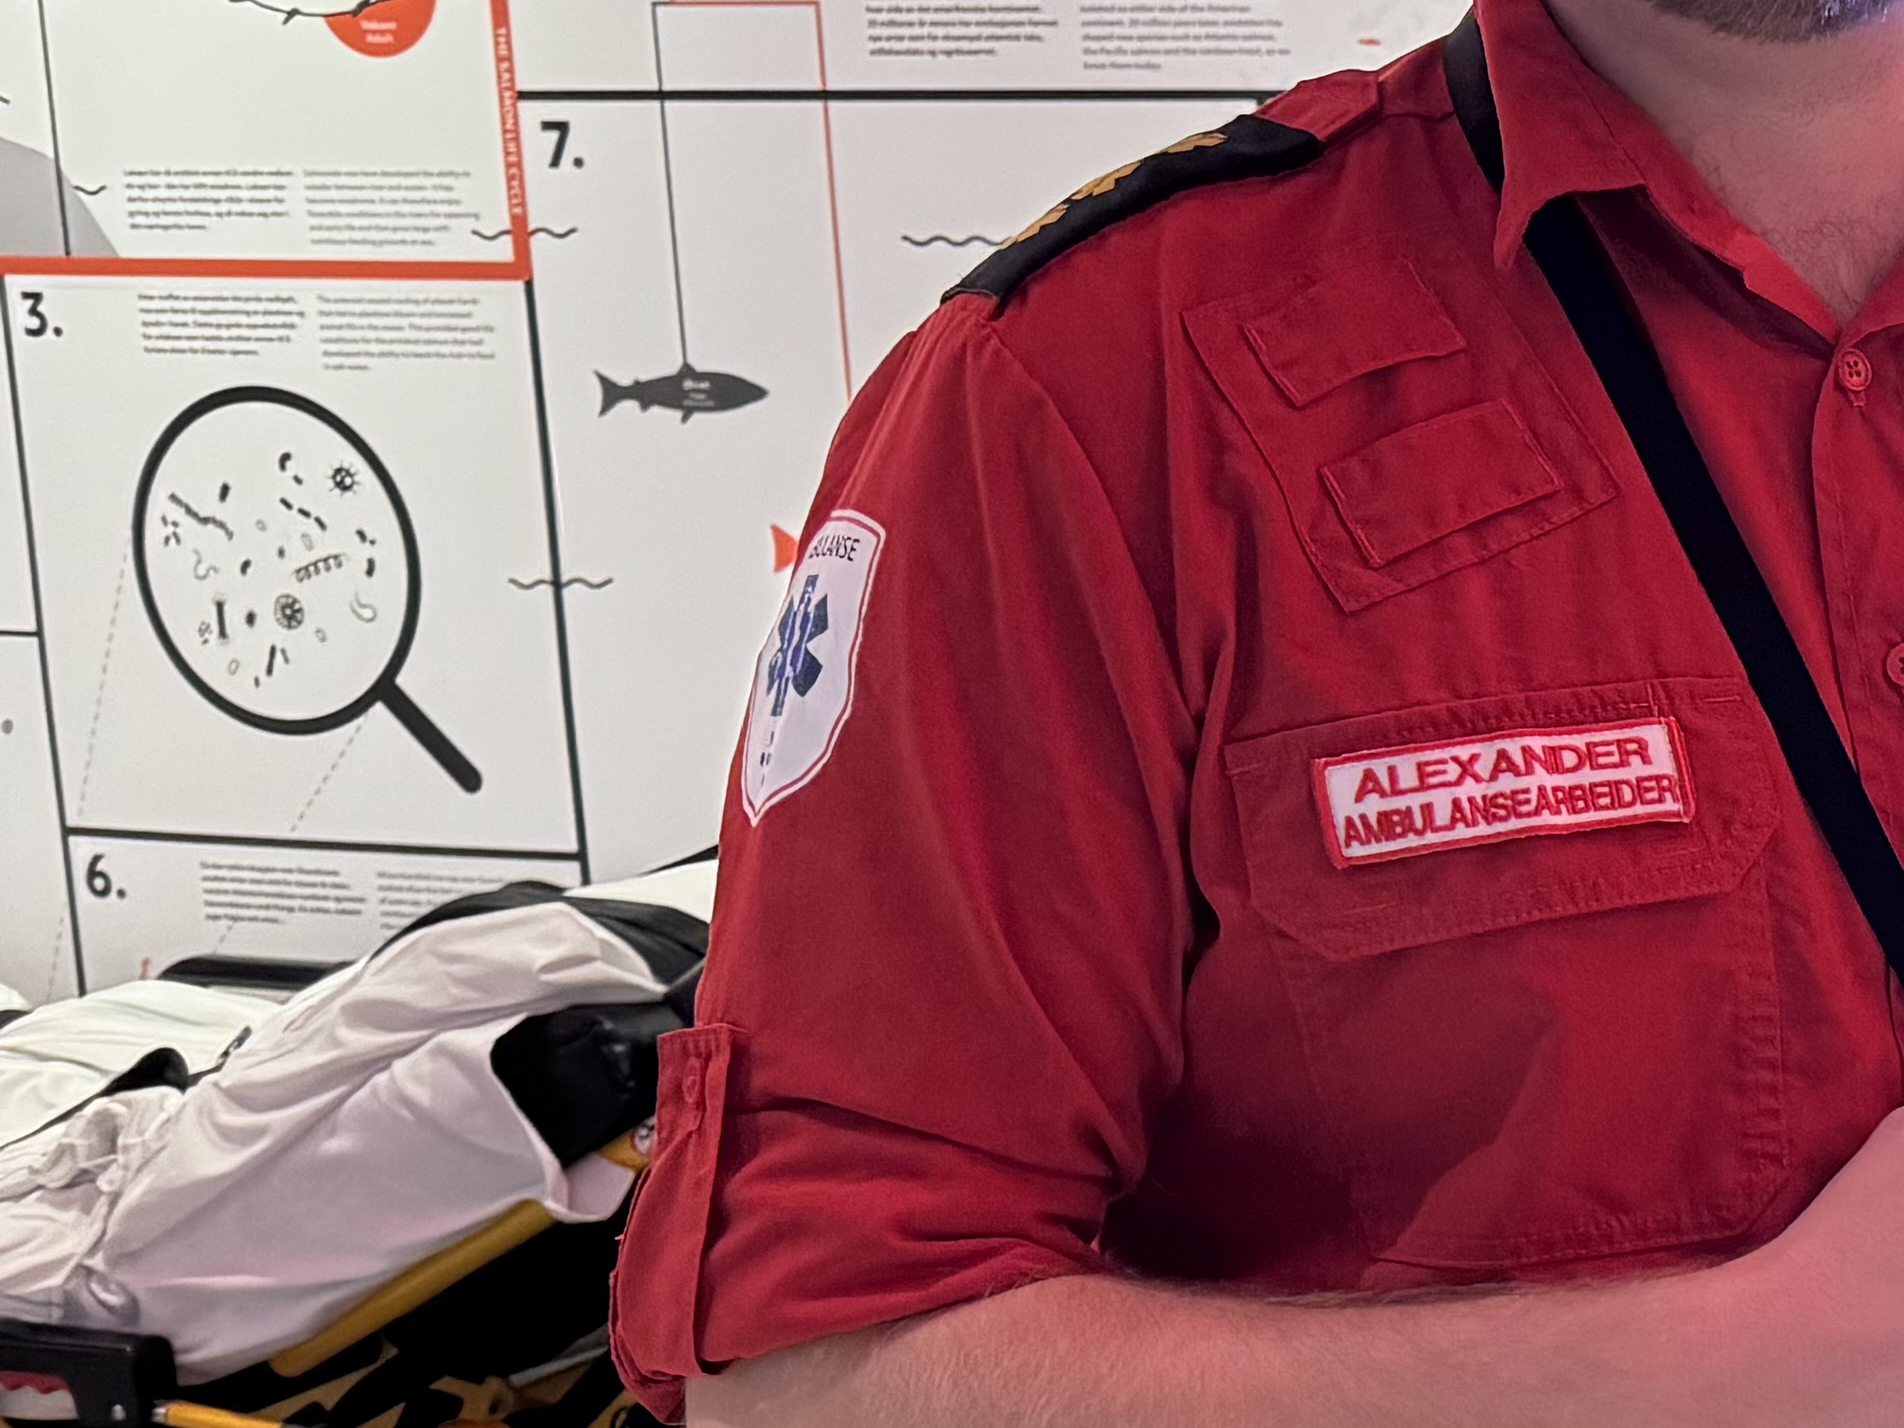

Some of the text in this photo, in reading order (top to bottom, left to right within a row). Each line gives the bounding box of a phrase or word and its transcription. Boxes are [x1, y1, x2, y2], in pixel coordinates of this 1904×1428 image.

[540, 121, 584, 170] 7.
[21, 292, 64, 338] 3.
[1354, 737, 1653, 803] ALEXANDER
[1343, 772, 1680, 849] AMBULANSEARBEIDER
[85, 854, 128, 900] 6.
